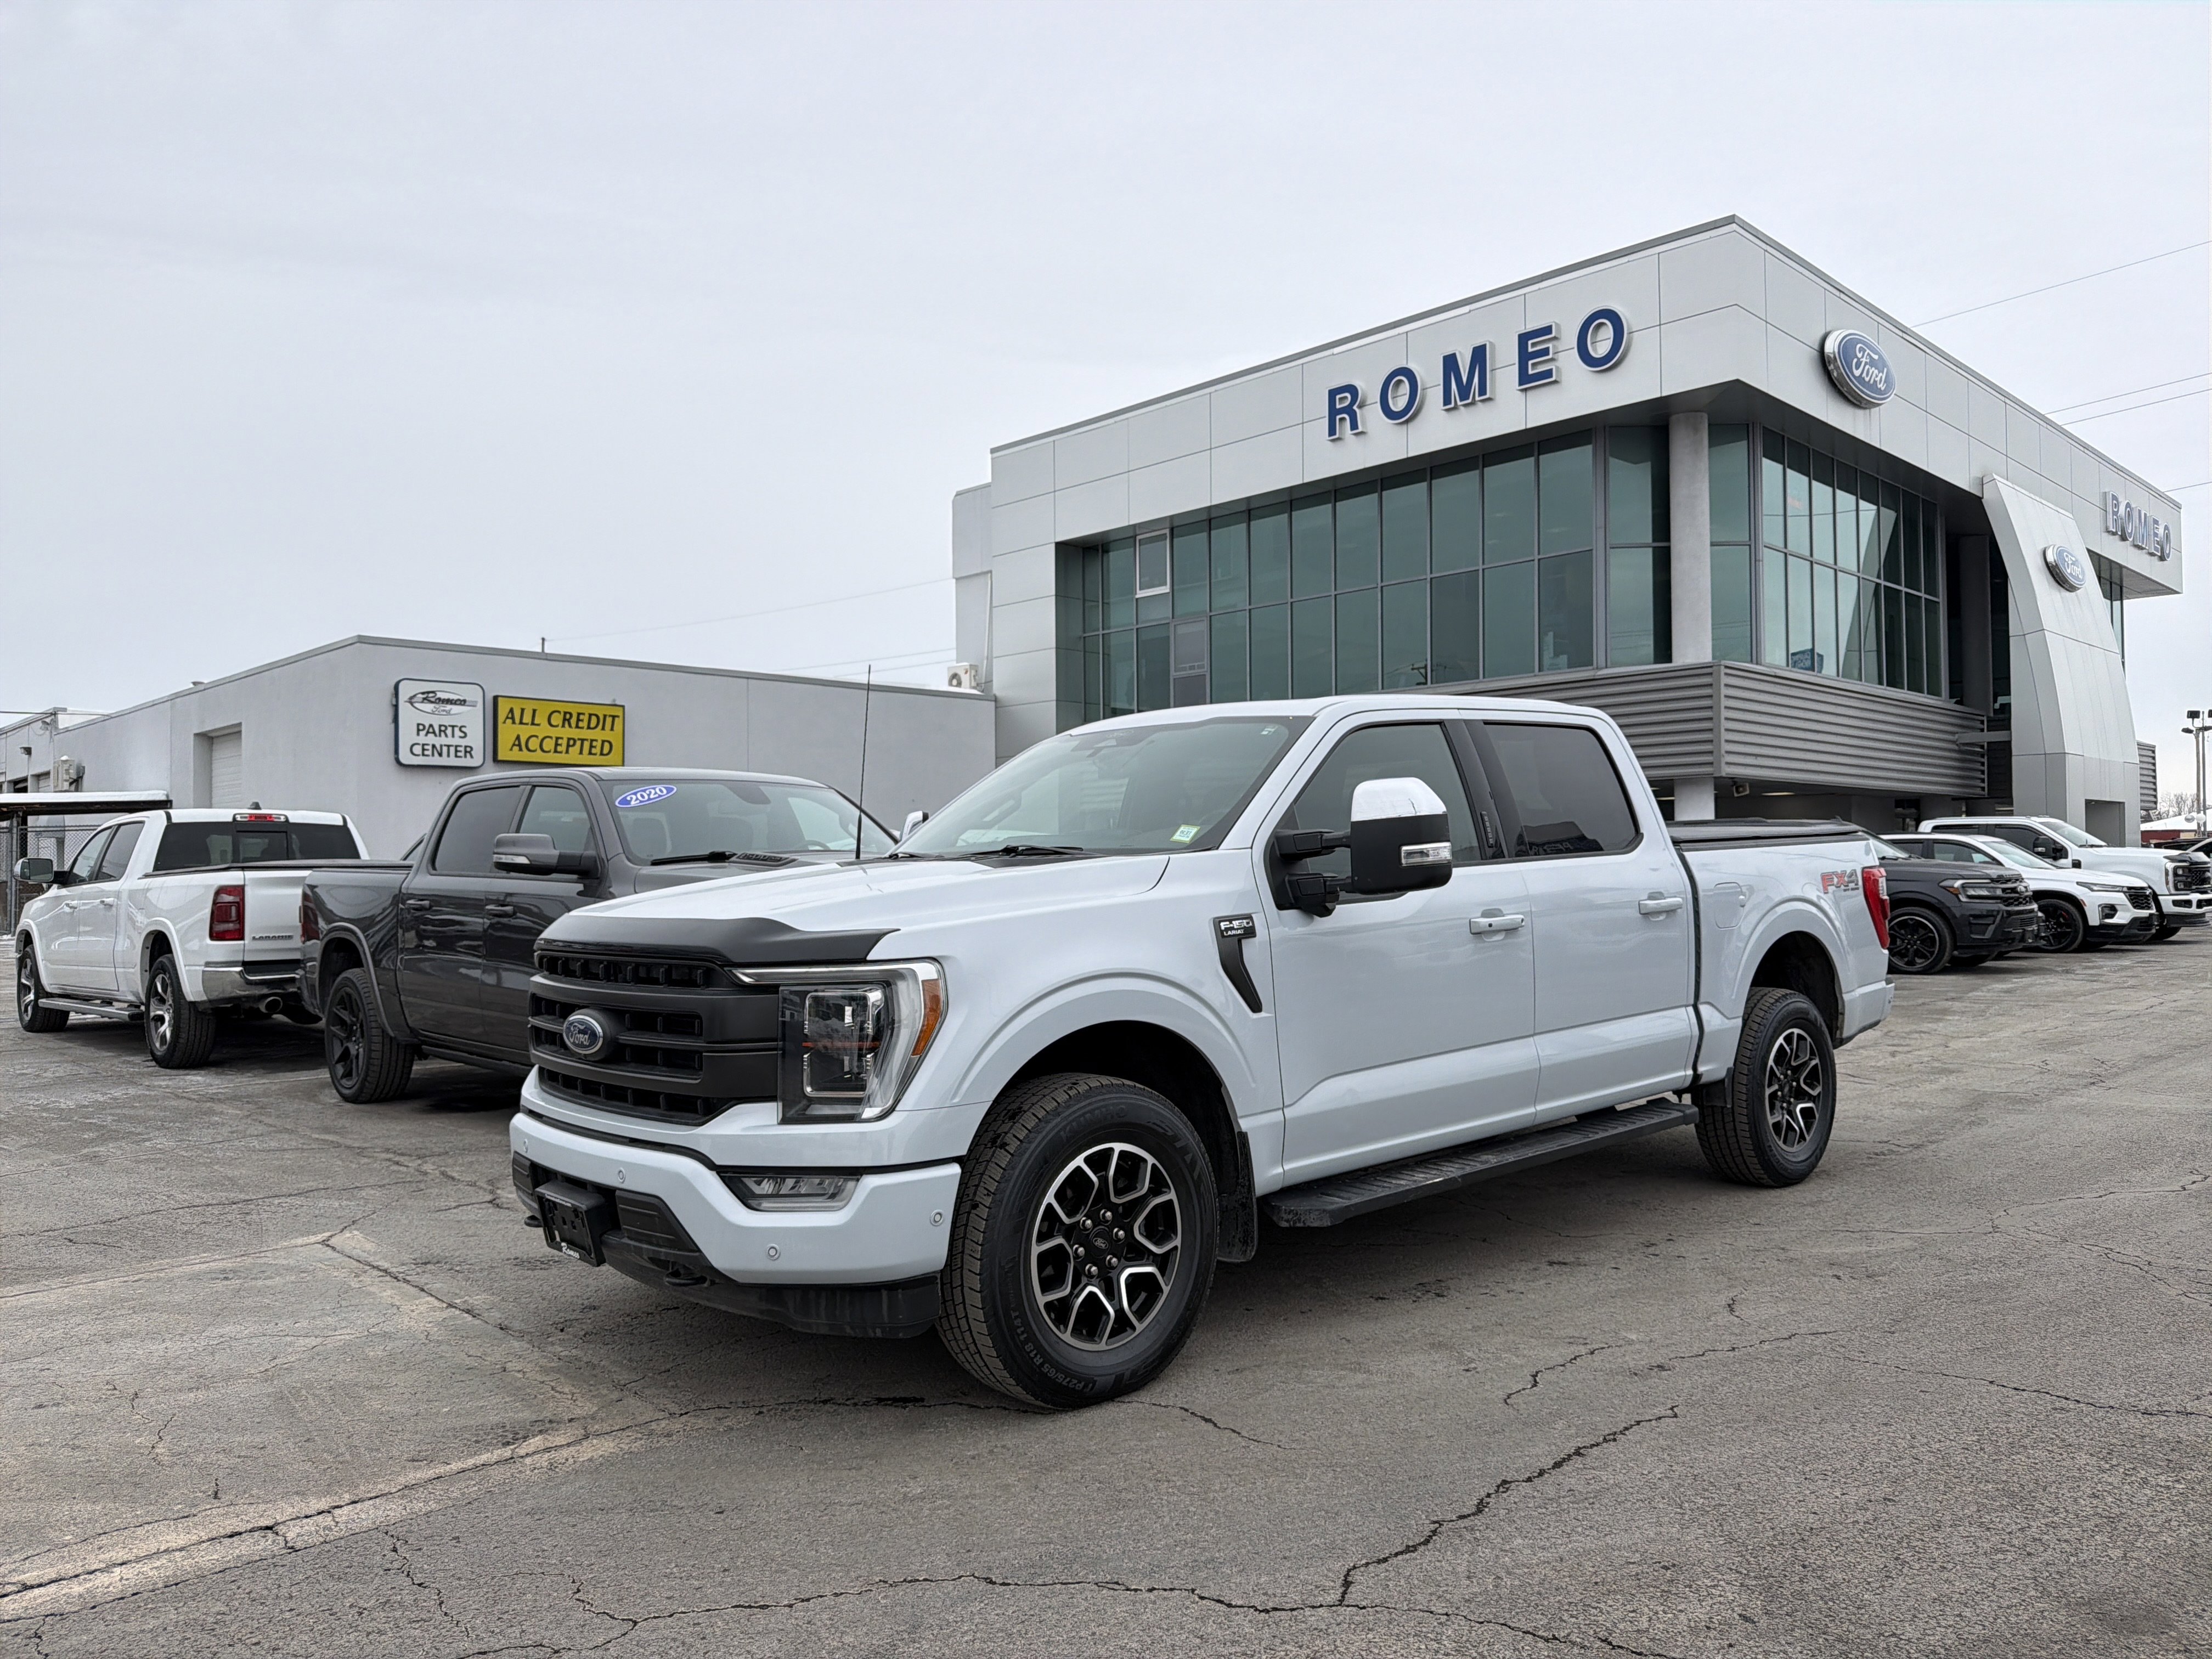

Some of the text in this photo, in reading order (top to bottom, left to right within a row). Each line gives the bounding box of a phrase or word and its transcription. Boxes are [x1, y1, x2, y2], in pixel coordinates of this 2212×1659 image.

[1326, 305, 1631, 440] ROMEO
[1852, 343, 1887, 391] Ford
[2106, 491, 2171, 561] ROMEO
[2063, 552, 2083, 579] Ford
[416, 723, 467, 739] PARTS
[503, 707, 620, 732] ALL CREDIT
[409, 742, 474, 759] CENTER
[509, 733, 614, 757] ACCEPTED
[626, 787, 667, 805] 2020
[1820, 869, 1859, 894] FX4
[1220, 919, 1253, 930] F-150
[569, 1023, 591, 1046] Ford
[1010, 1310, 1028, 1340] 114T
[1025, 1342, 1044, 1365] R18
[1041, 1363, 1085, 1391] P275/65
